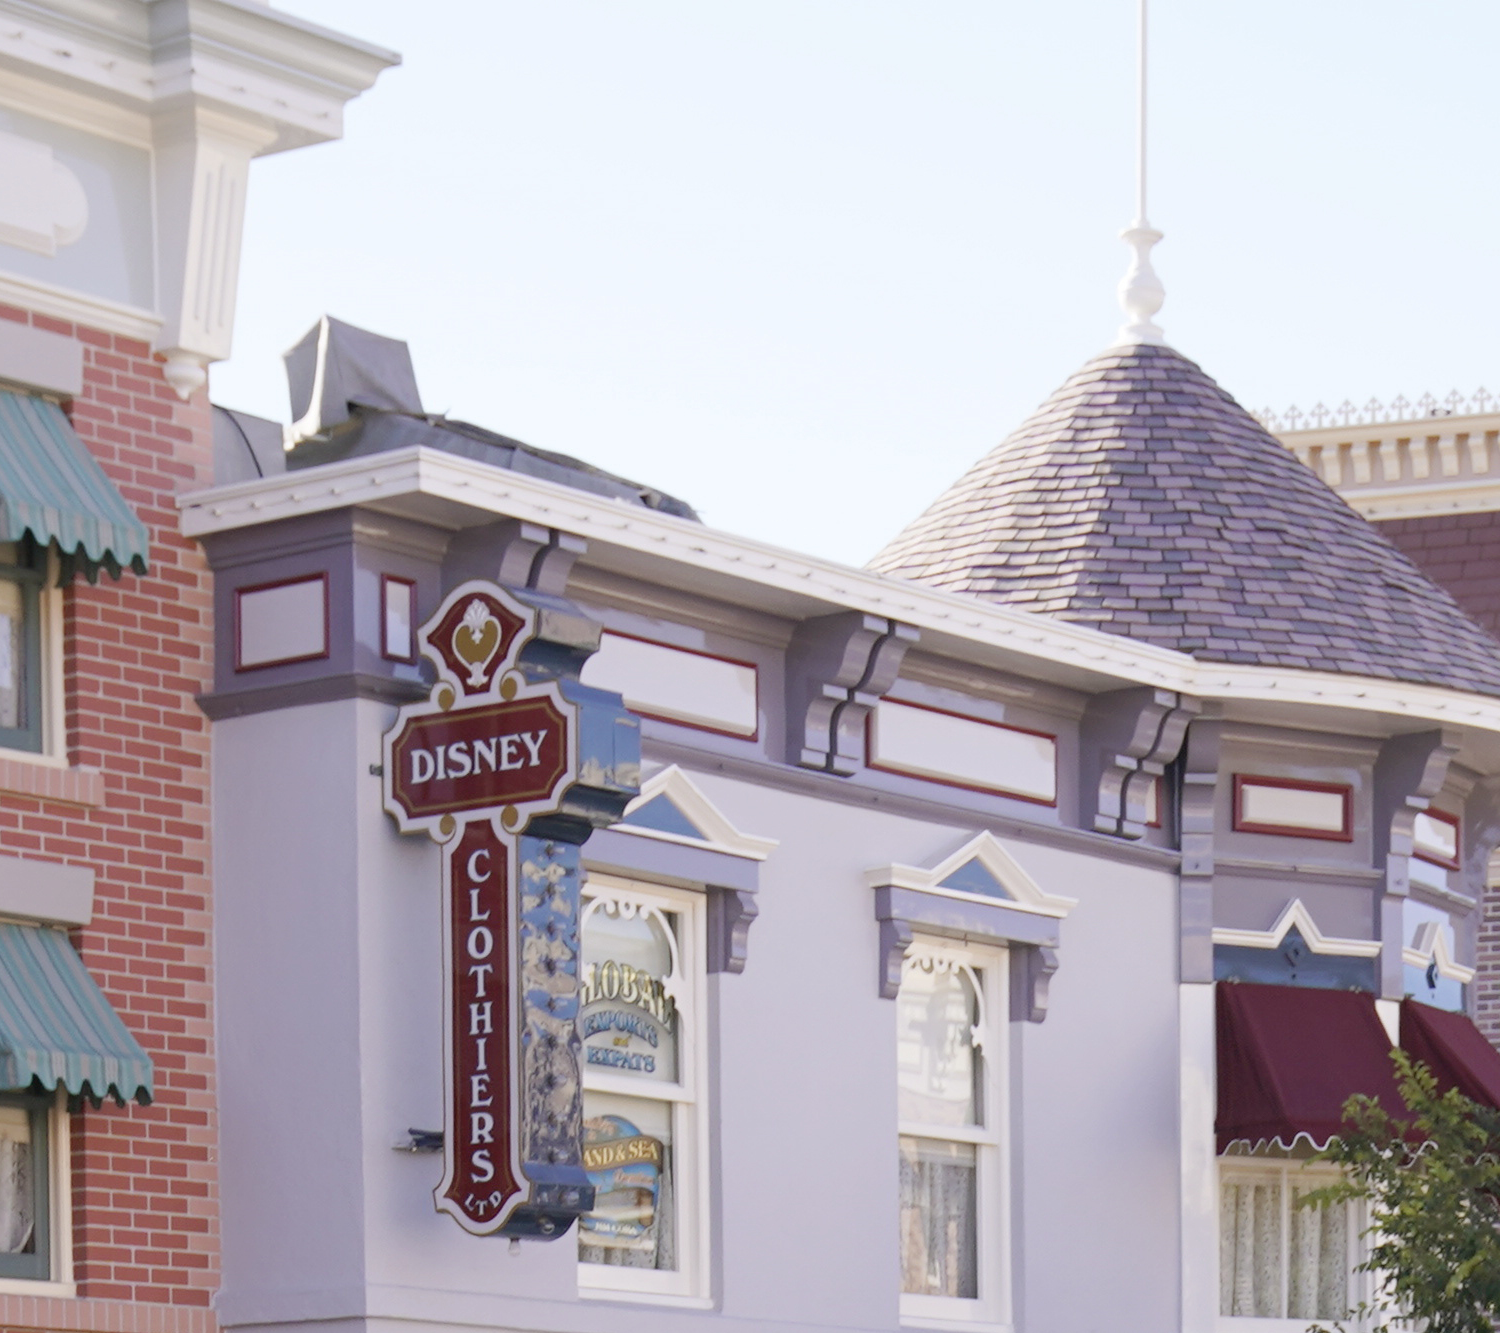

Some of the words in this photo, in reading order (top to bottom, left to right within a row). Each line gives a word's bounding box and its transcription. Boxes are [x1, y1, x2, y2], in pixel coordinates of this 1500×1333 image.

[410, 729, 548, 785] DISNEY
[466, 849, 495, 1184] CLOTHIERS
[583, 1146, 614, 1167] AND
[628, 1138, 658, 1160] SEA
[464, 1189, 503, 1217] LTD
